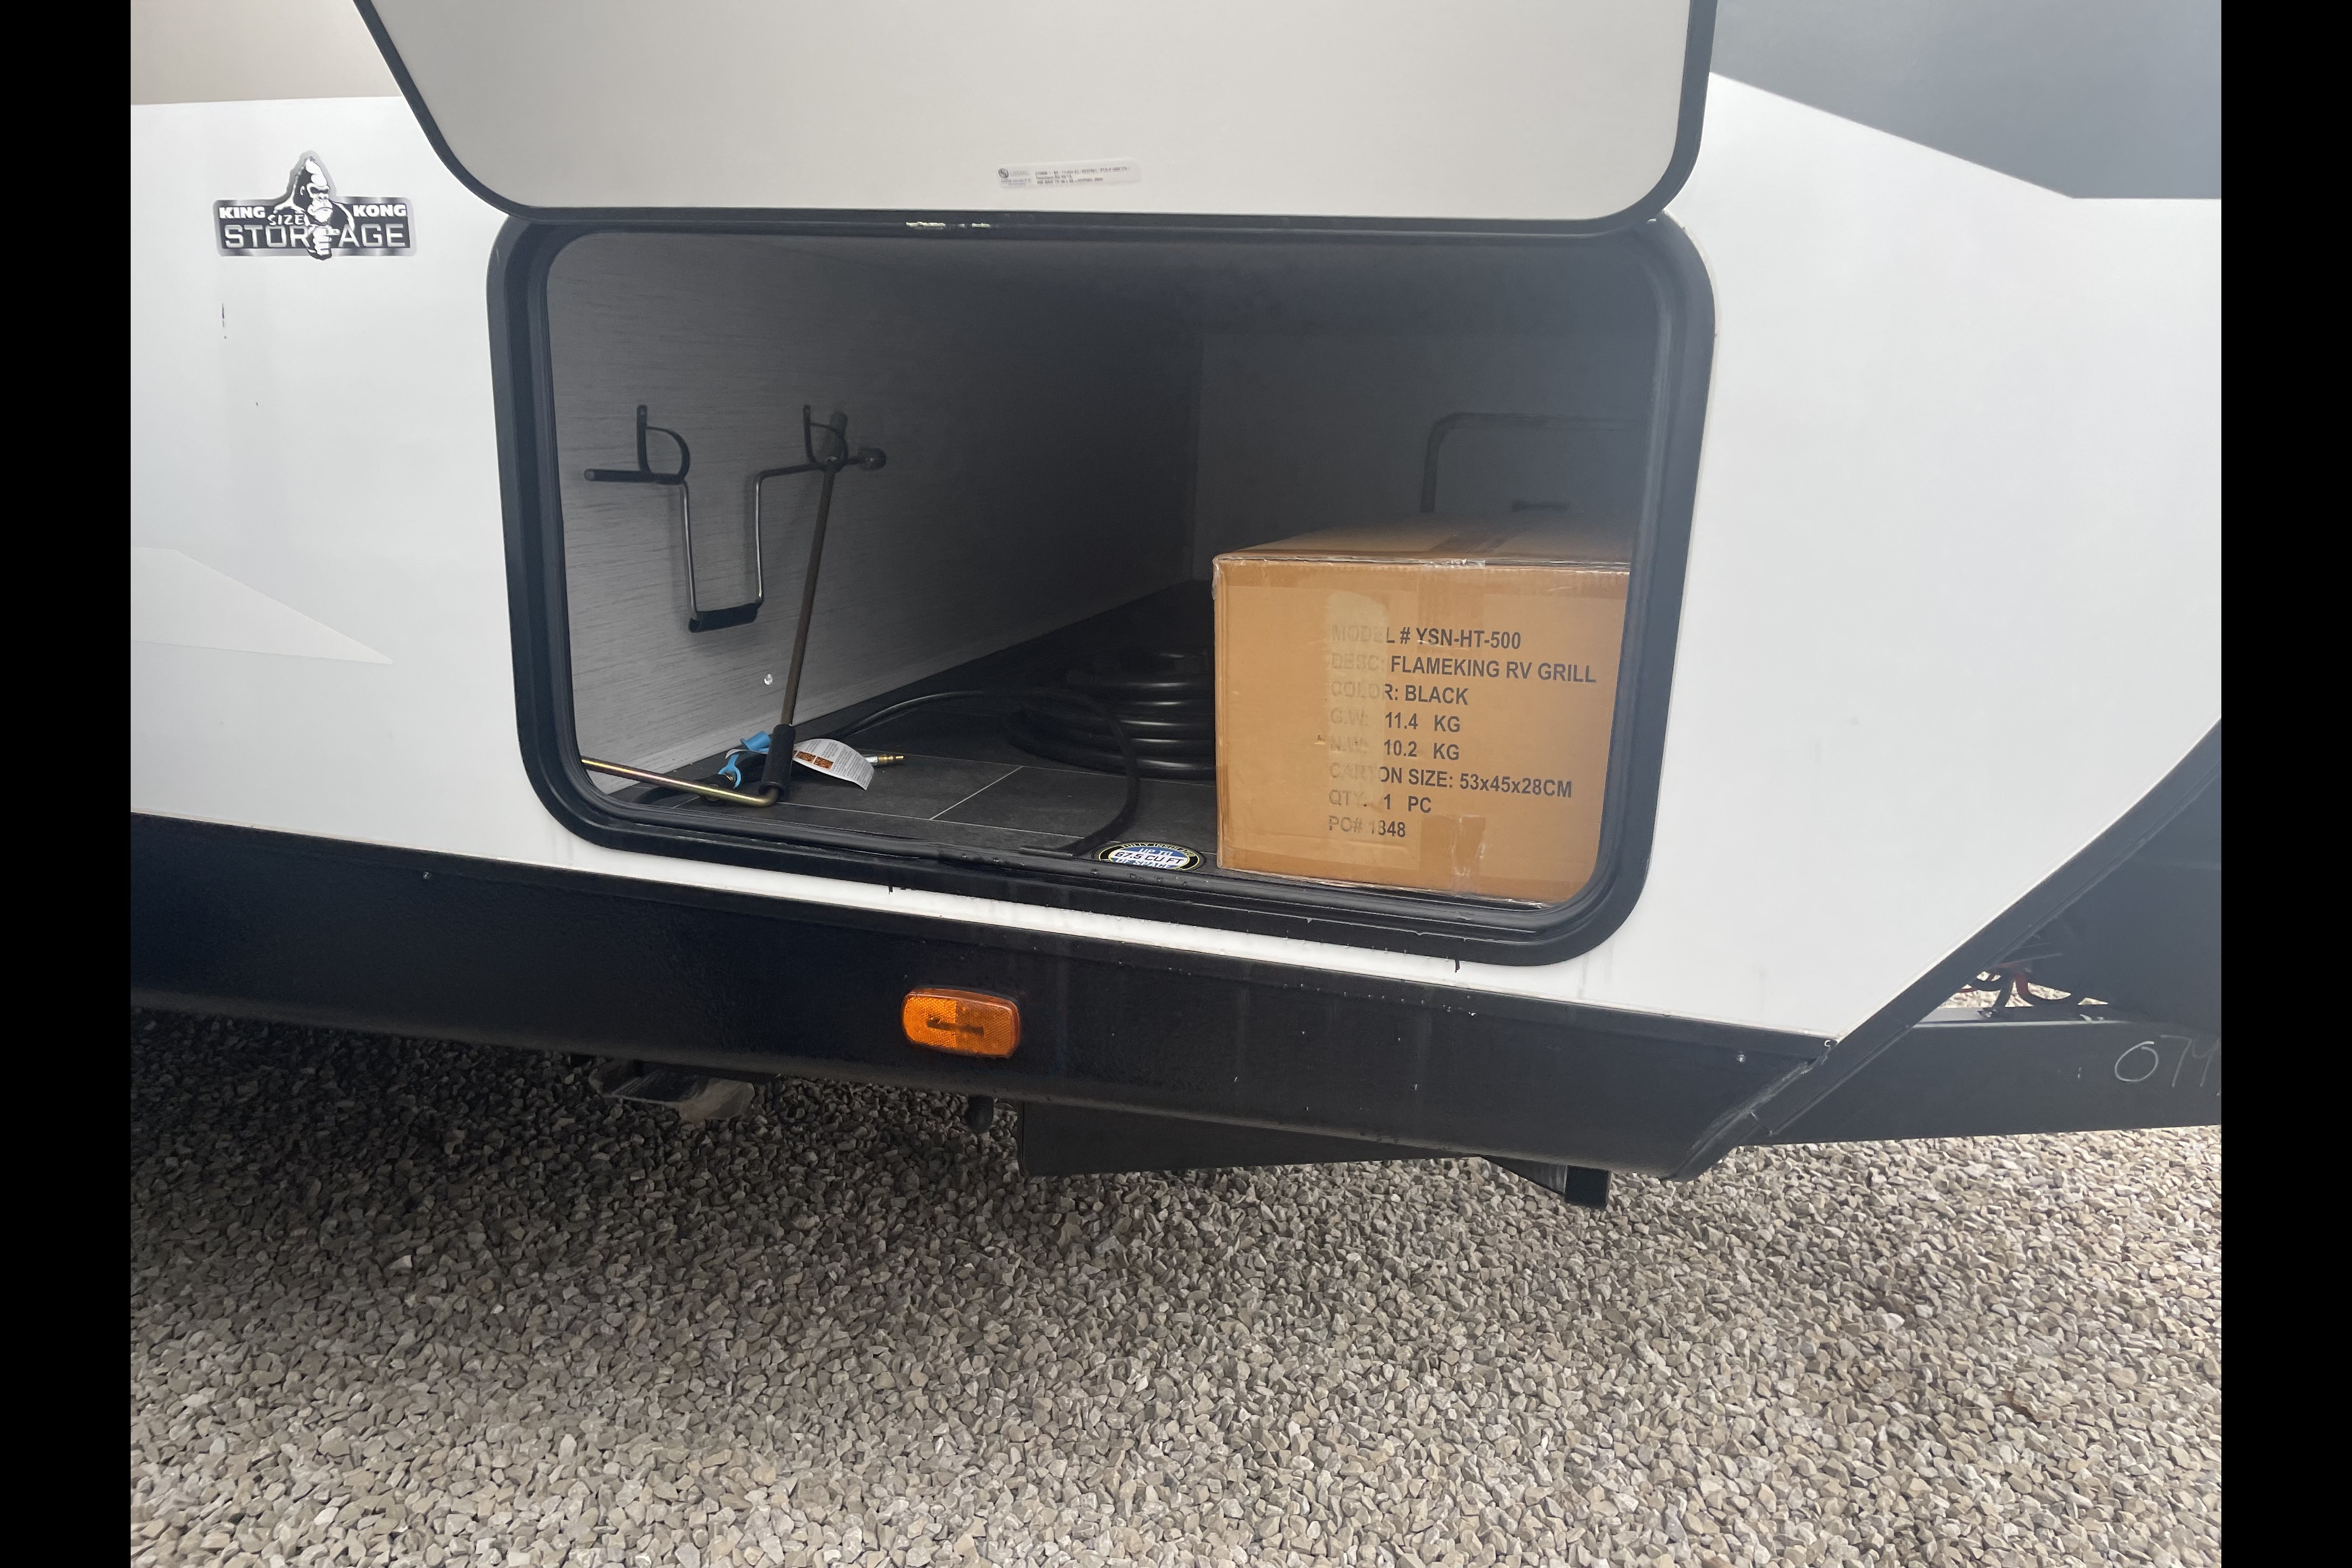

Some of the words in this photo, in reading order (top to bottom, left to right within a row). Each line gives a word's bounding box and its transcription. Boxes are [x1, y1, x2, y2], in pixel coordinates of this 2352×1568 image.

[219, 206, 266, 219] KING
[268, 214, 306, 227] SIZE
[353, 204, 407, 217] KONG
[224, 223, 406, 249] STORAGE
[1331, 624, 1395, 644] MODEL
[1399, 626, 1411, 645] #
[1415, 627, 1521, 650] YSN-HT-500
[1331, 652, 1384, 671] DESC:
[1390, 655, 1500, 678] FLAMEKING
[1506, 661, 1532, 680] RV
[1537, 662, 1597, 683] GRILL
[1331, 680, 1398, 701] COLOR:
[1405, 684, 1468, 706] BLACK
[1384, 711, 1419, 730] 11.4
[1434, 715, 1461, 734] KG
[1383, 738, 1418, 758] 10.2
[1433, 742, 1460, 761] KG
[1408, 769, 1453, 789] SIZE:
[1459, 775, 1572, 798] 53x45x28CM
[1383, 793, 1391, 810] 1
[1407, 796, 1432, 814] PC
[1328, 815, 1363, 834] PO#
[1368, 818, 1406, 838] 1848
